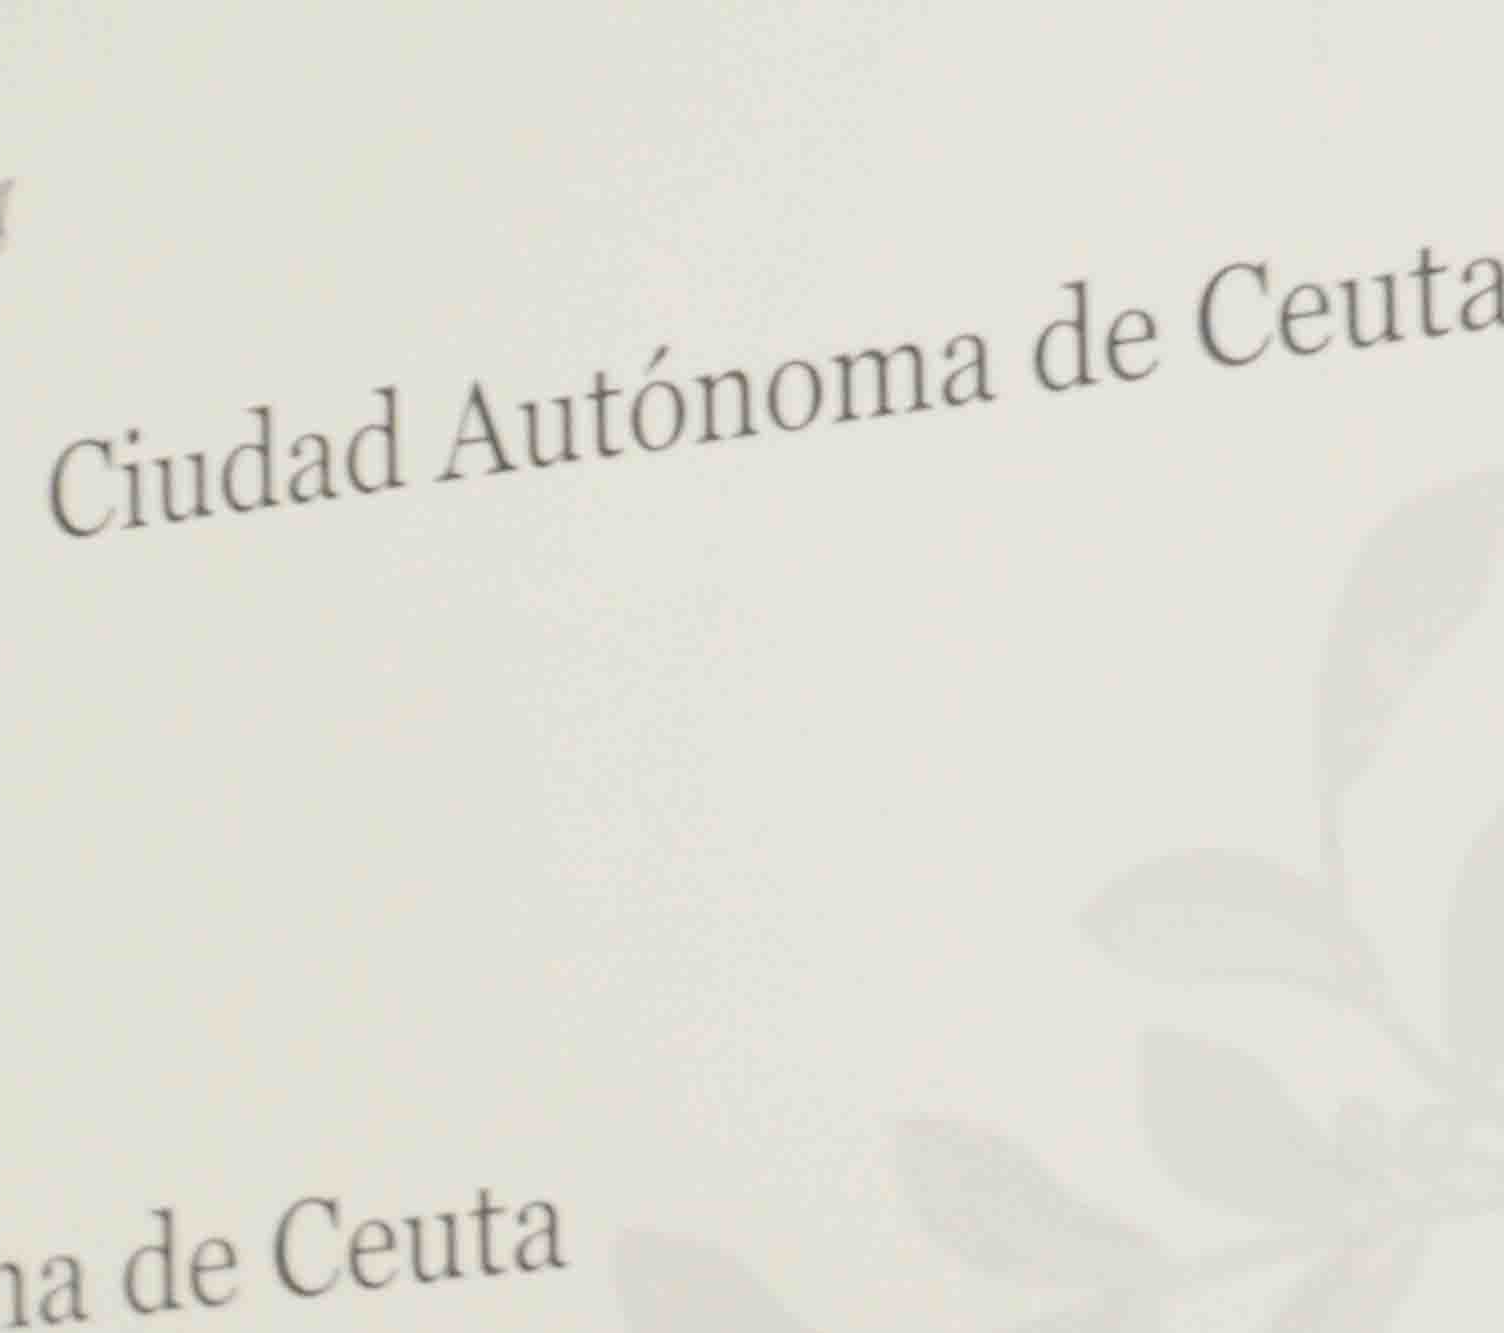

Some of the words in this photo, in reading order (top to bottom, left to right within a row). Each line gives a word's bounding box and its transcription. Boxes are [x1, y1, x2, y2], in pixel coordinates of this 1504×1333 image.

[47, 386, 407, 540] Ciudad
[435, 330, 997, 483] Autónoma
[1033, 280, 1158, 394] de
[122, 1208, 239, 1316] de
[271, 1187, 569, 1299] Ceuta
